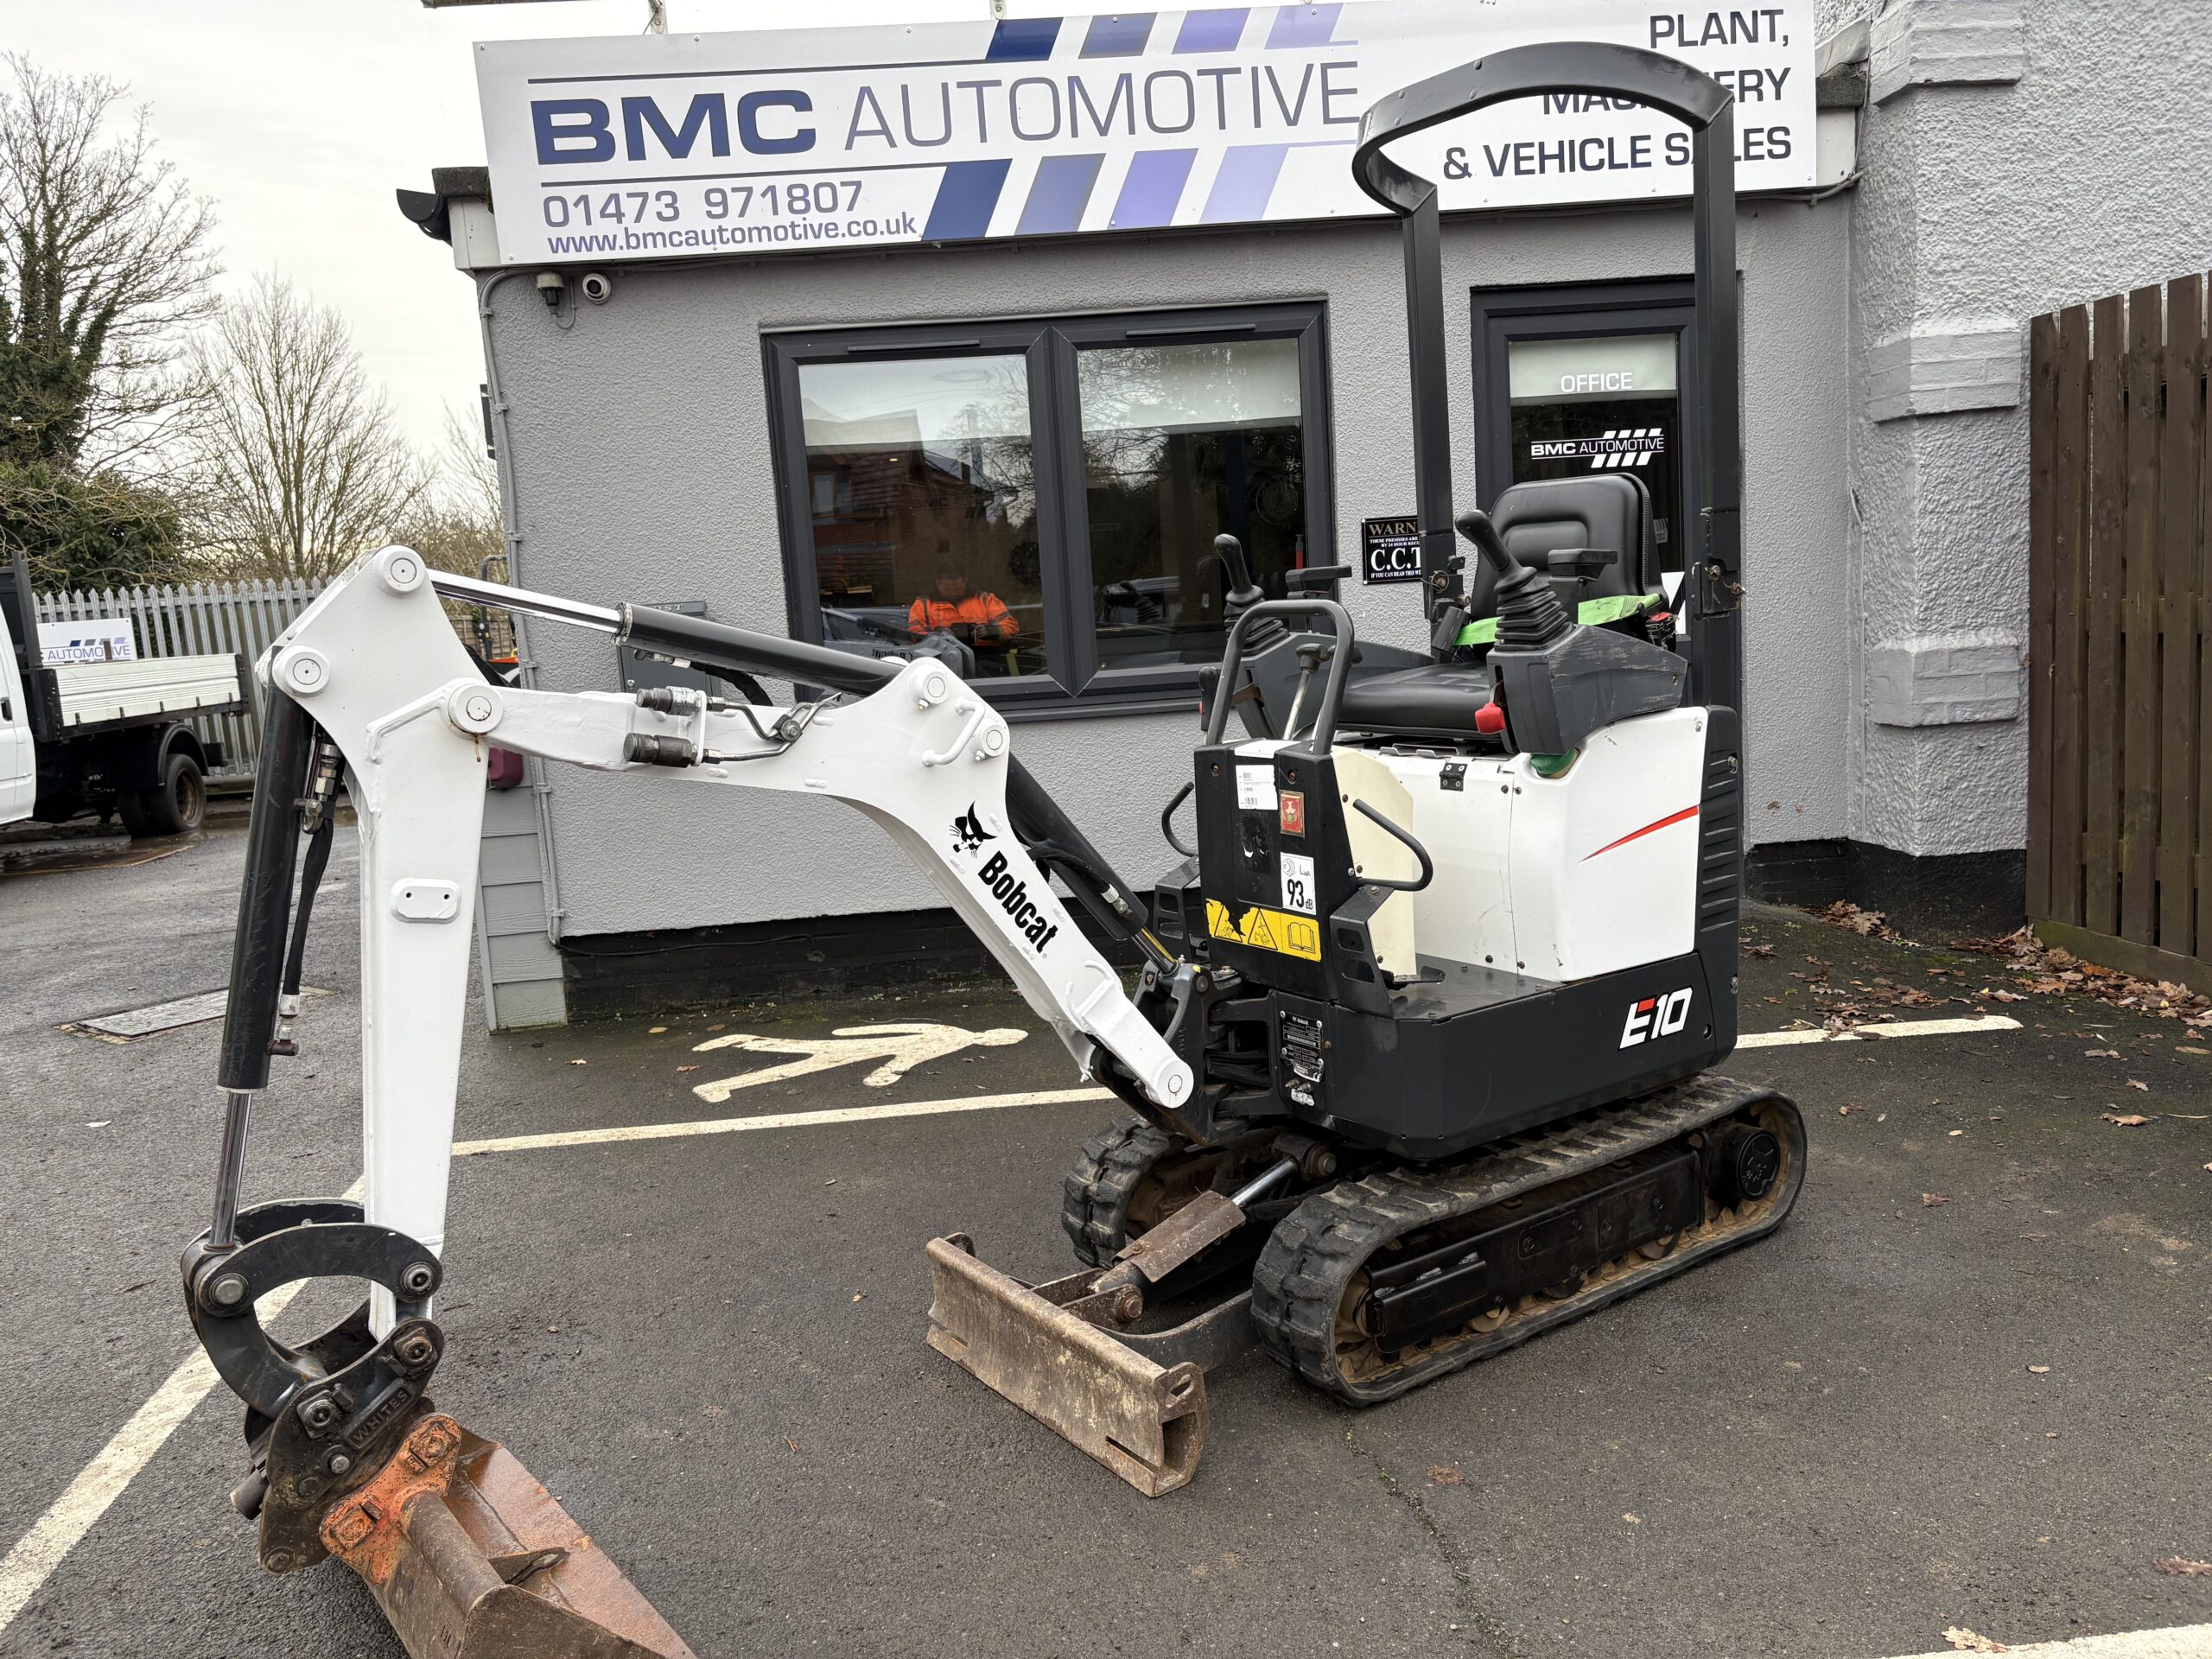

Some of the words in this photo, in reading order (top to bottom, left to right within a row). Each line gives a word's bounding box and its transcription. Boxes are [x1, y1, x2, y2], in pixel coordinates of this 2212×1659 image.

[1649, 10, 1789, 48] PLANT,
[531, 88, 817, 165] BMC
[844, 60, 1360, 151] AUTOMOTIVE
[1443, 147, 1472, 180] &
[1483, 135, 1652, 176] VEHICLE
[1664, 126, 1792, 167] SES
[543, 190, 680, 228] 01473
[704, 180, 862, 219] 971807
[547, 211, 918, 254] www.bmcautomotive.co.uk
[1560, 372, 1632, 393] OFFICE
[1531, 442, 1576, 456] BMC
[1579, 437, 1665, 454] AUTOMOTIVE
[1369, 522, 1417, 536] WARN
[48, 645, 131, 661] AUTOMOIVE
[978, 850, 1058, 954] Bobcat
[1287, 878, 1305, 908] 93
[1305, 898, 1313, 910] dB
[1618, 987, 1694, 1050] E10
[353, 1390, 408, 1442] WHITES
